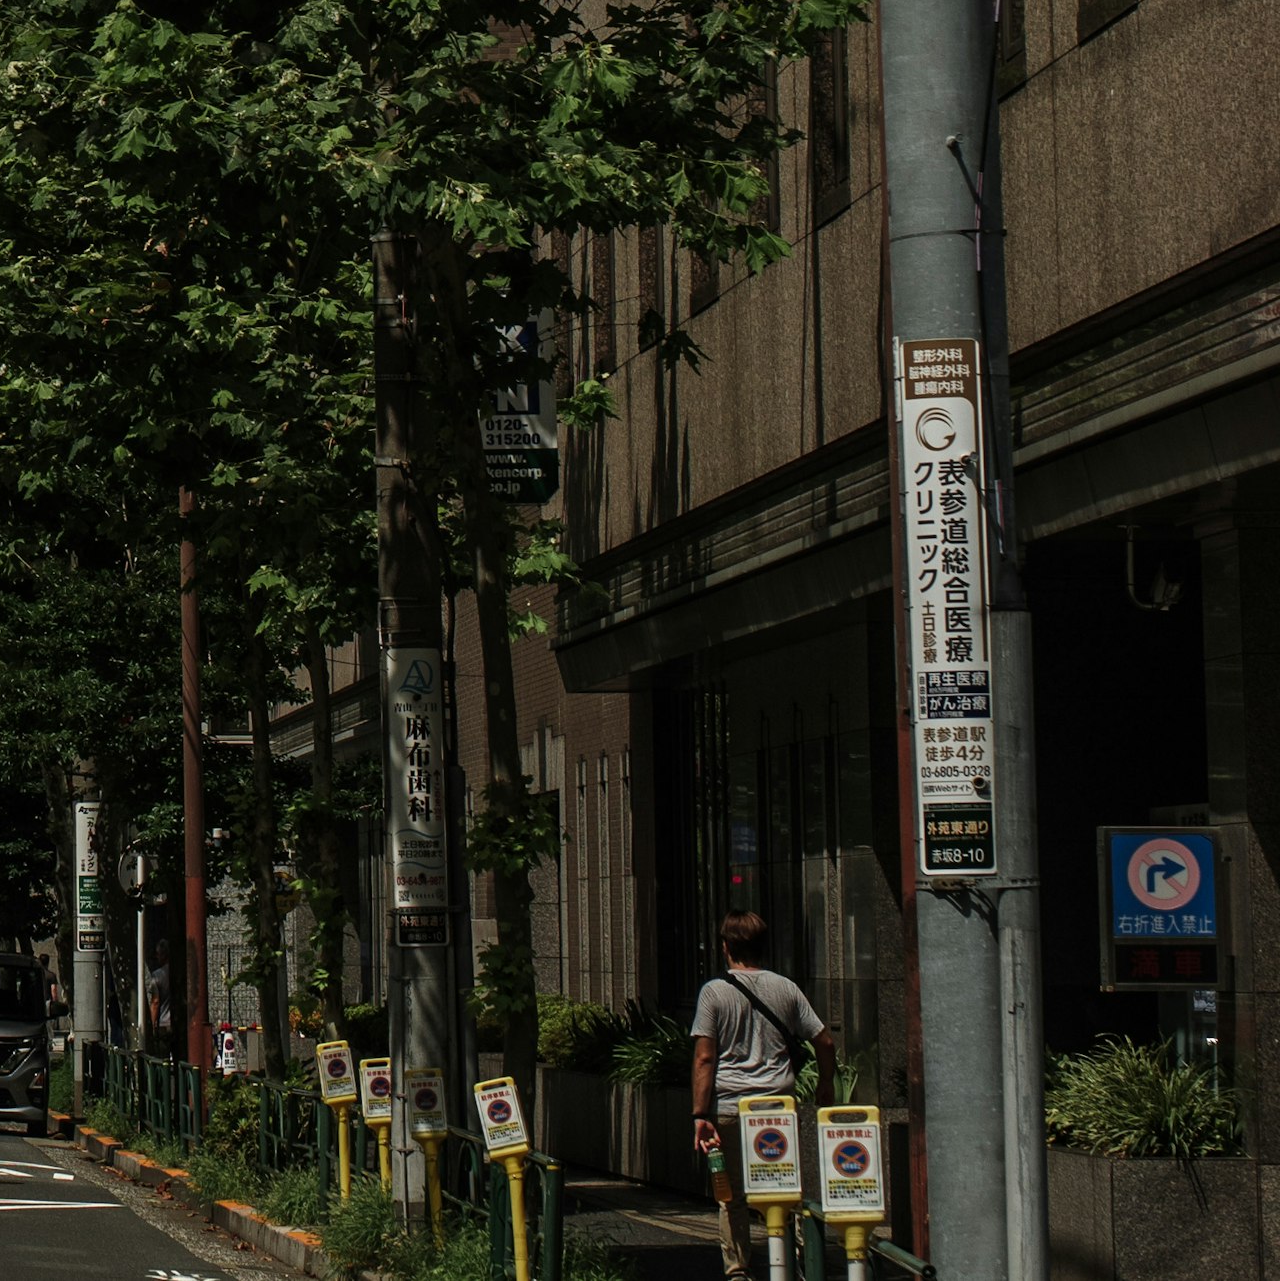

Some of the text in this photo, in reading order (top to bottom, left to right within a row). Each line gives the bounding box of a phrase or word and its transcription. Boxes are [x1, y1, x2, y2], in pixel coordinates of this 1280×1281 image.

[913, 348, 963, 363] 整形外科
[486, 419, 528, 431] 0120-
[486, 433, 540, 446] 315200
[914, 462, 938, 593] クリニック
[938, 459, 974, 663] 表参道総合医療
[921, 601, 938, 664] 土日診療
[928, 671, 987, 687] 再生医療
[929, 696, 988, 711] がん治療
[923, 726, 987, 743] 表参道駅
[925, 745, 985, 762] 徒歩4分
[406, 714, 432, 823] 麻布歯科
[921, 765, 991, 778] 03-6805-0328
[927, 820, 989, 836] 外苑東通り
[932, 847, 985, 864] 赤坂8-10
[1118, 914, 1213, 934] 右折進入禁止
[748, 1118, 790, 1127] 駐停車禁止
[826, 1129, 873, 1139] 駐停車禁止
